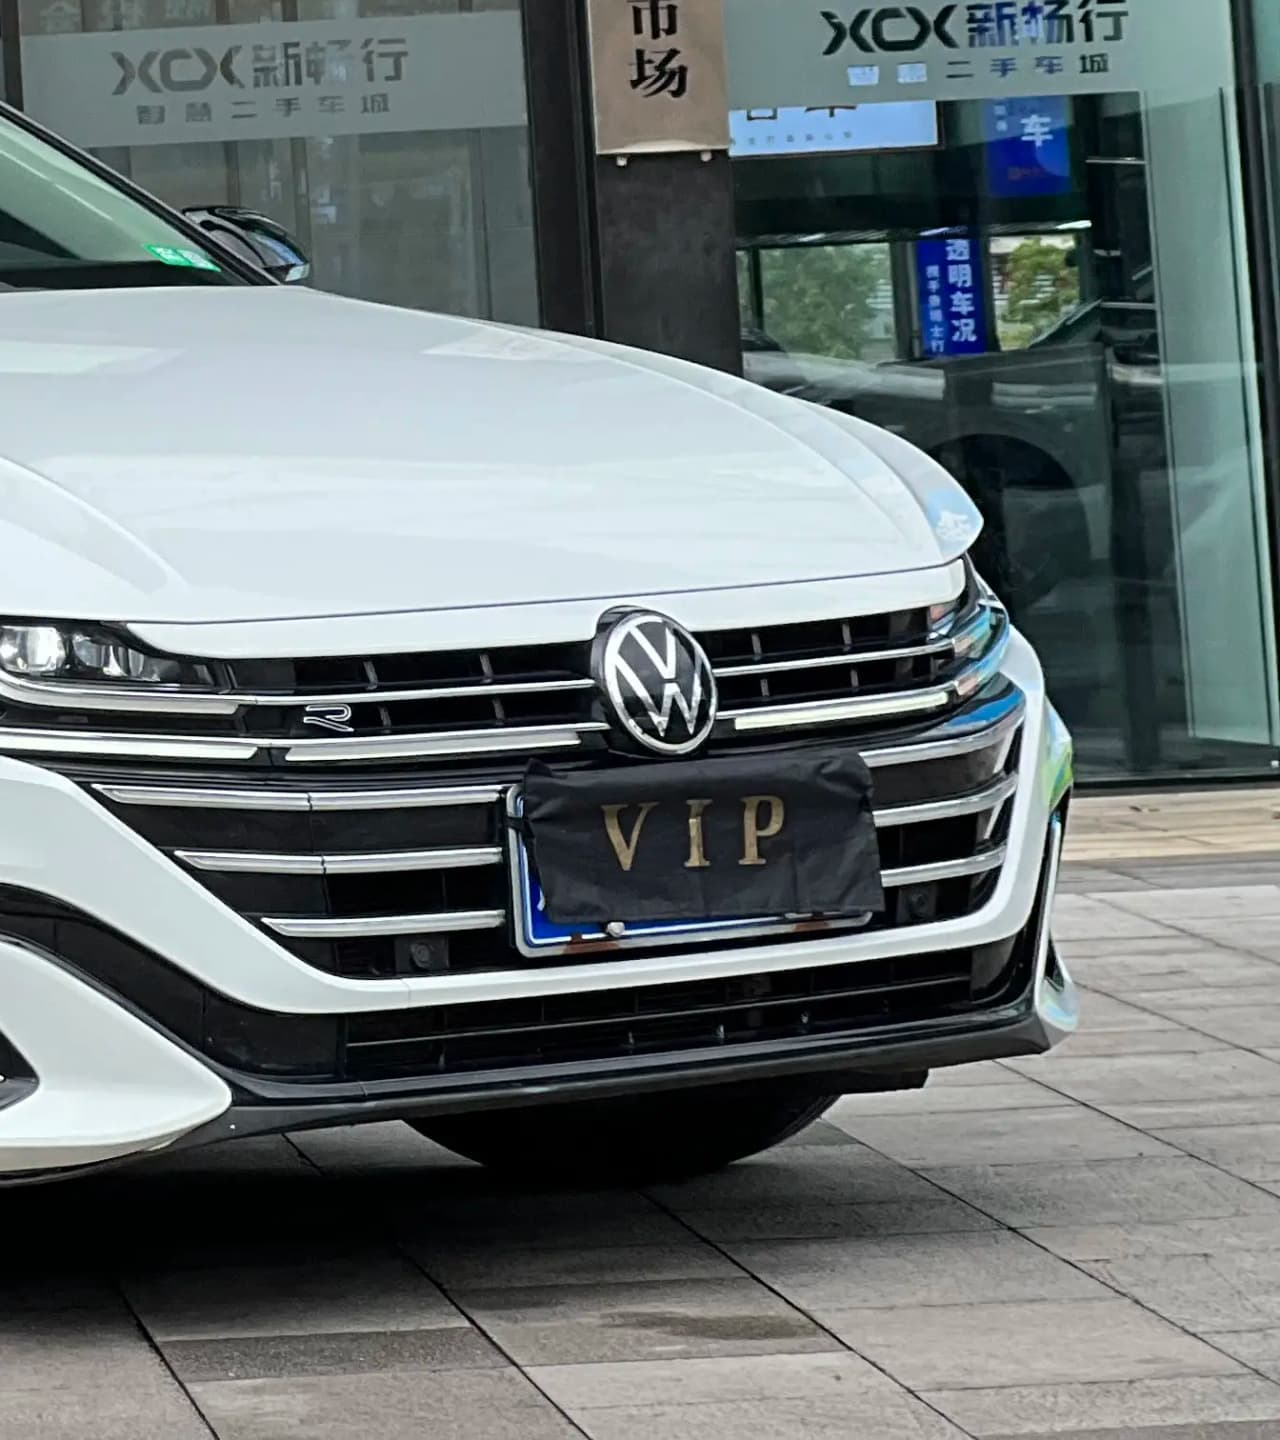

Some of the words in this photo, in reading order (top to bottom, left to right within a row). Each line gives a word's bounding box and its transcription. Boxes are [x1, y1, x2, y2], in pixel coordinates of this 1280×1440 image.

[945, 238, 977, 343] 透明车况
[601, 793, 786, 872] VIP
